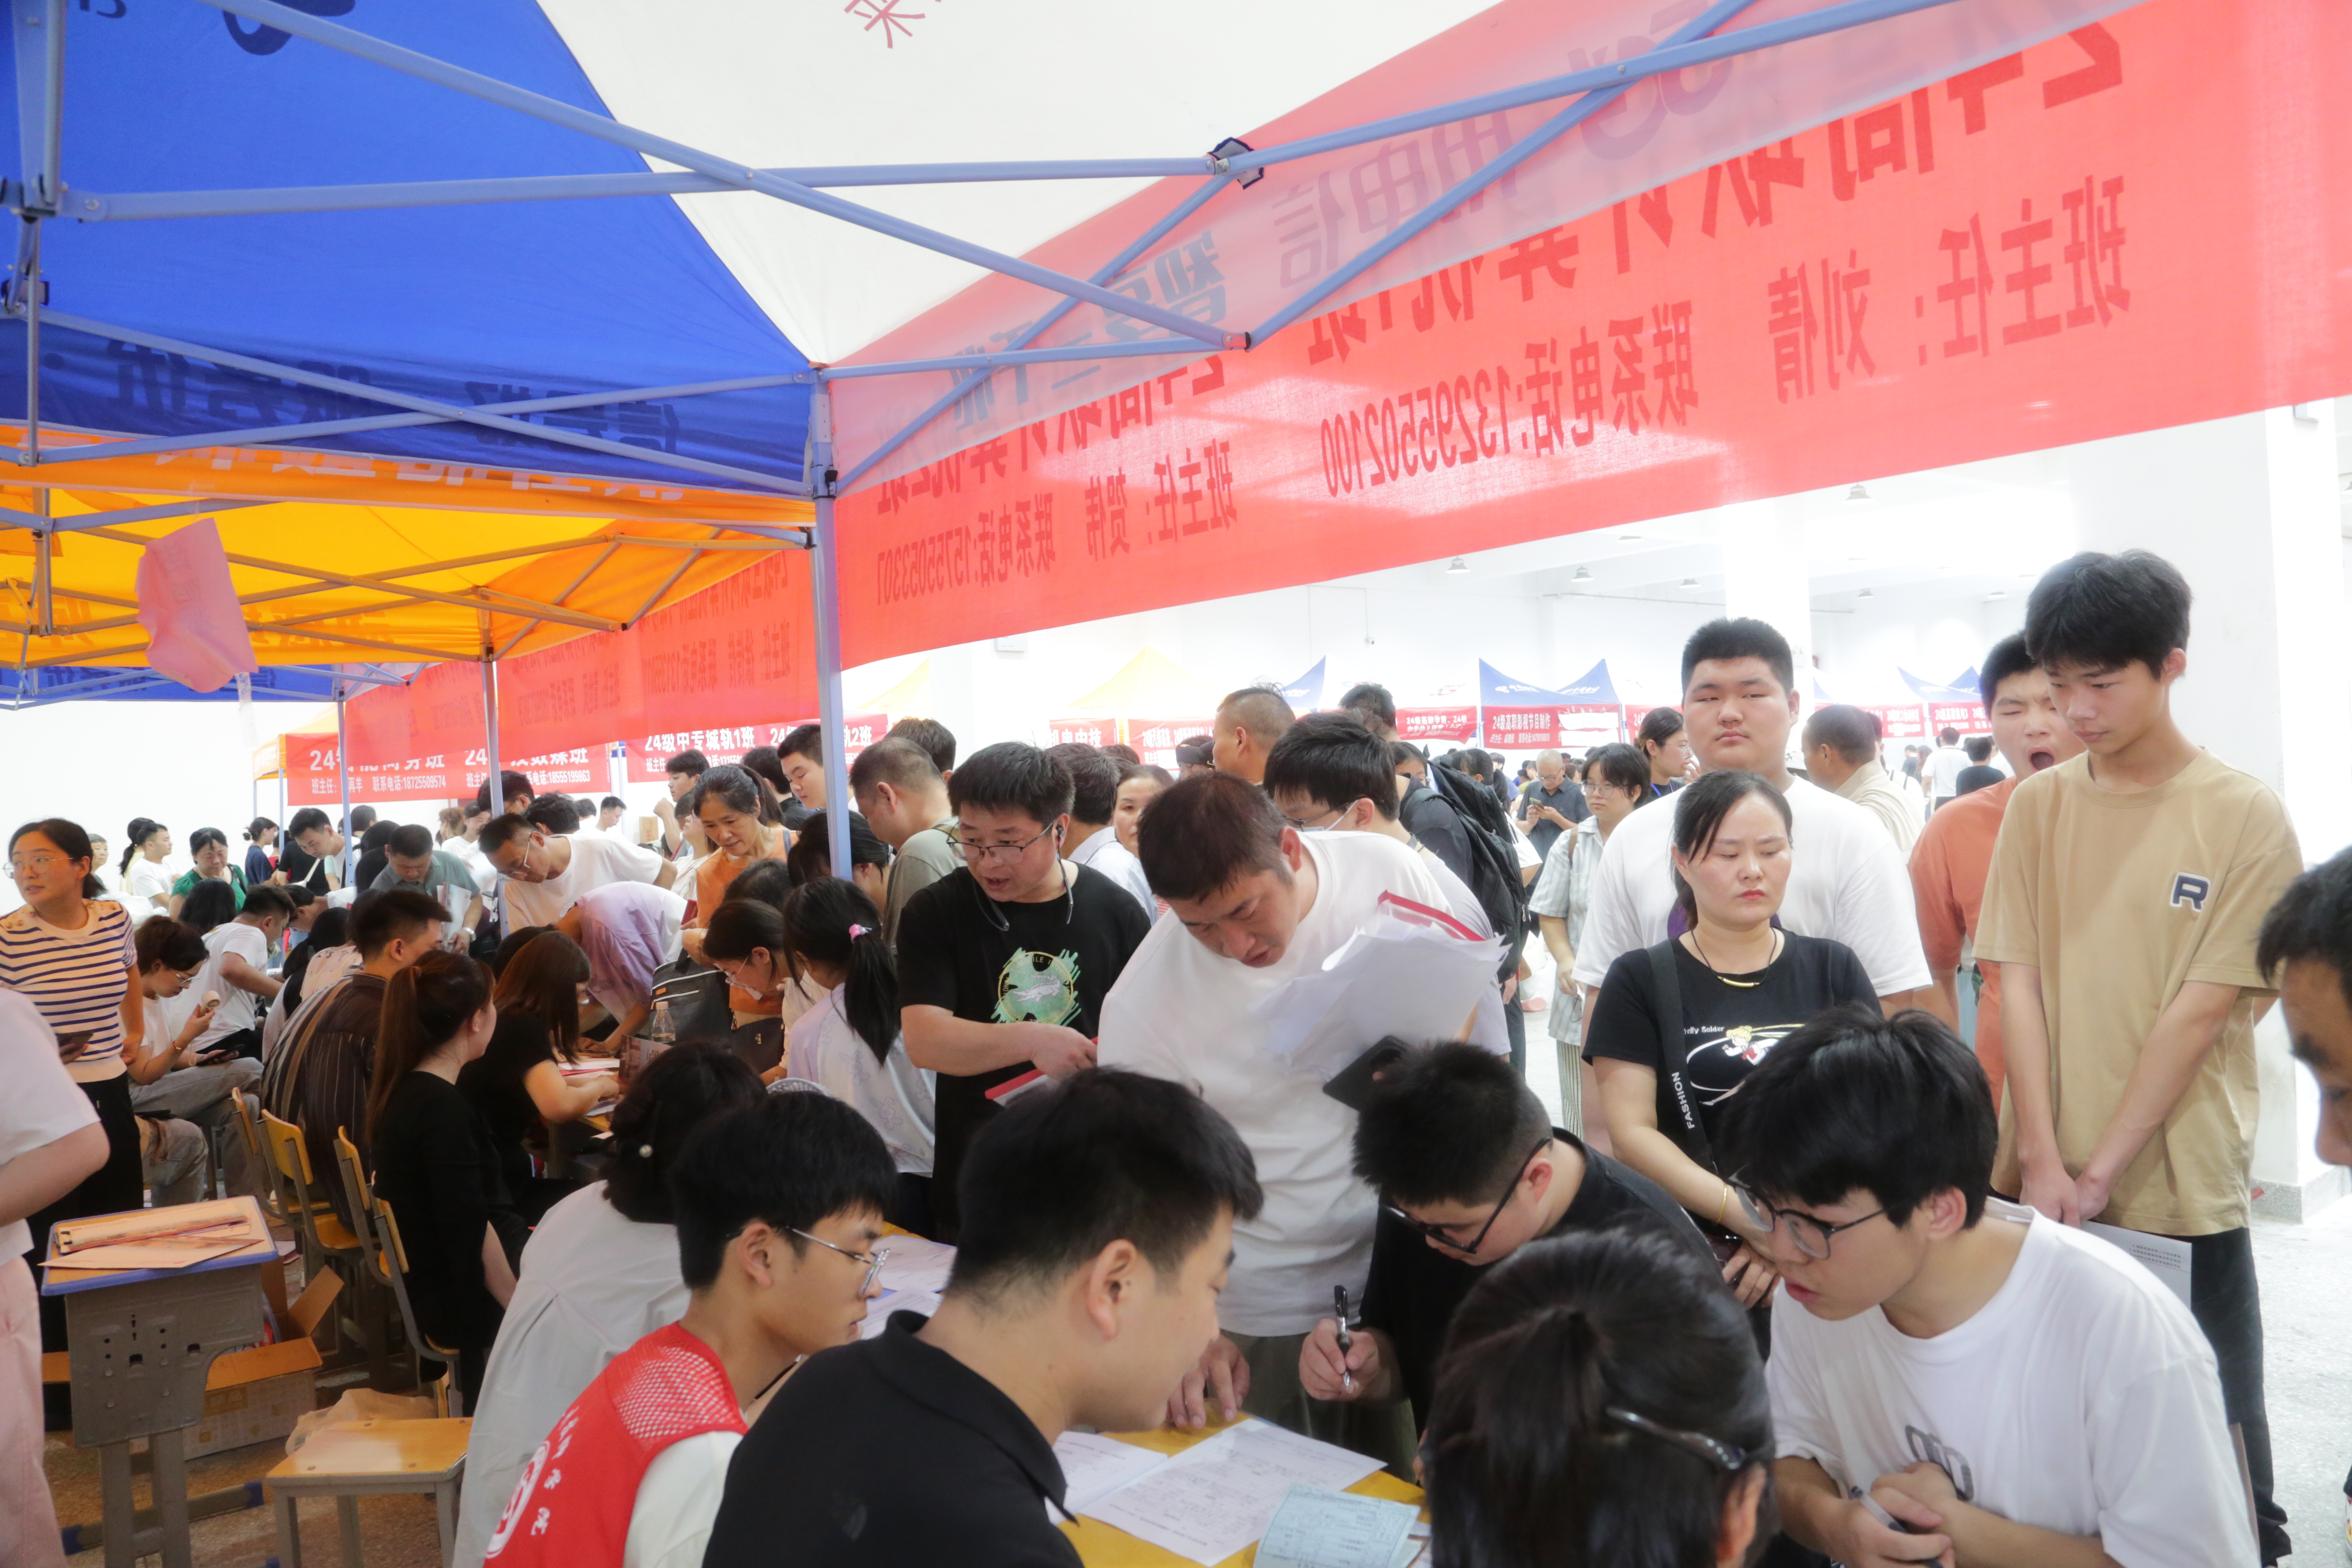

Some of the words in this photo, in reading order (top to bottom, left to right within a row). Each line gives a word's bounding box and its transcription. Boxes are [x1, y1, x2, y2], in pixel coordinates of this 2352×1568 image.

[518, 769, 591, 786] 系电话:18555199863
[2170, 872, 2211, 912] R
[1672, 1071, 1695, 1129] FASHION
